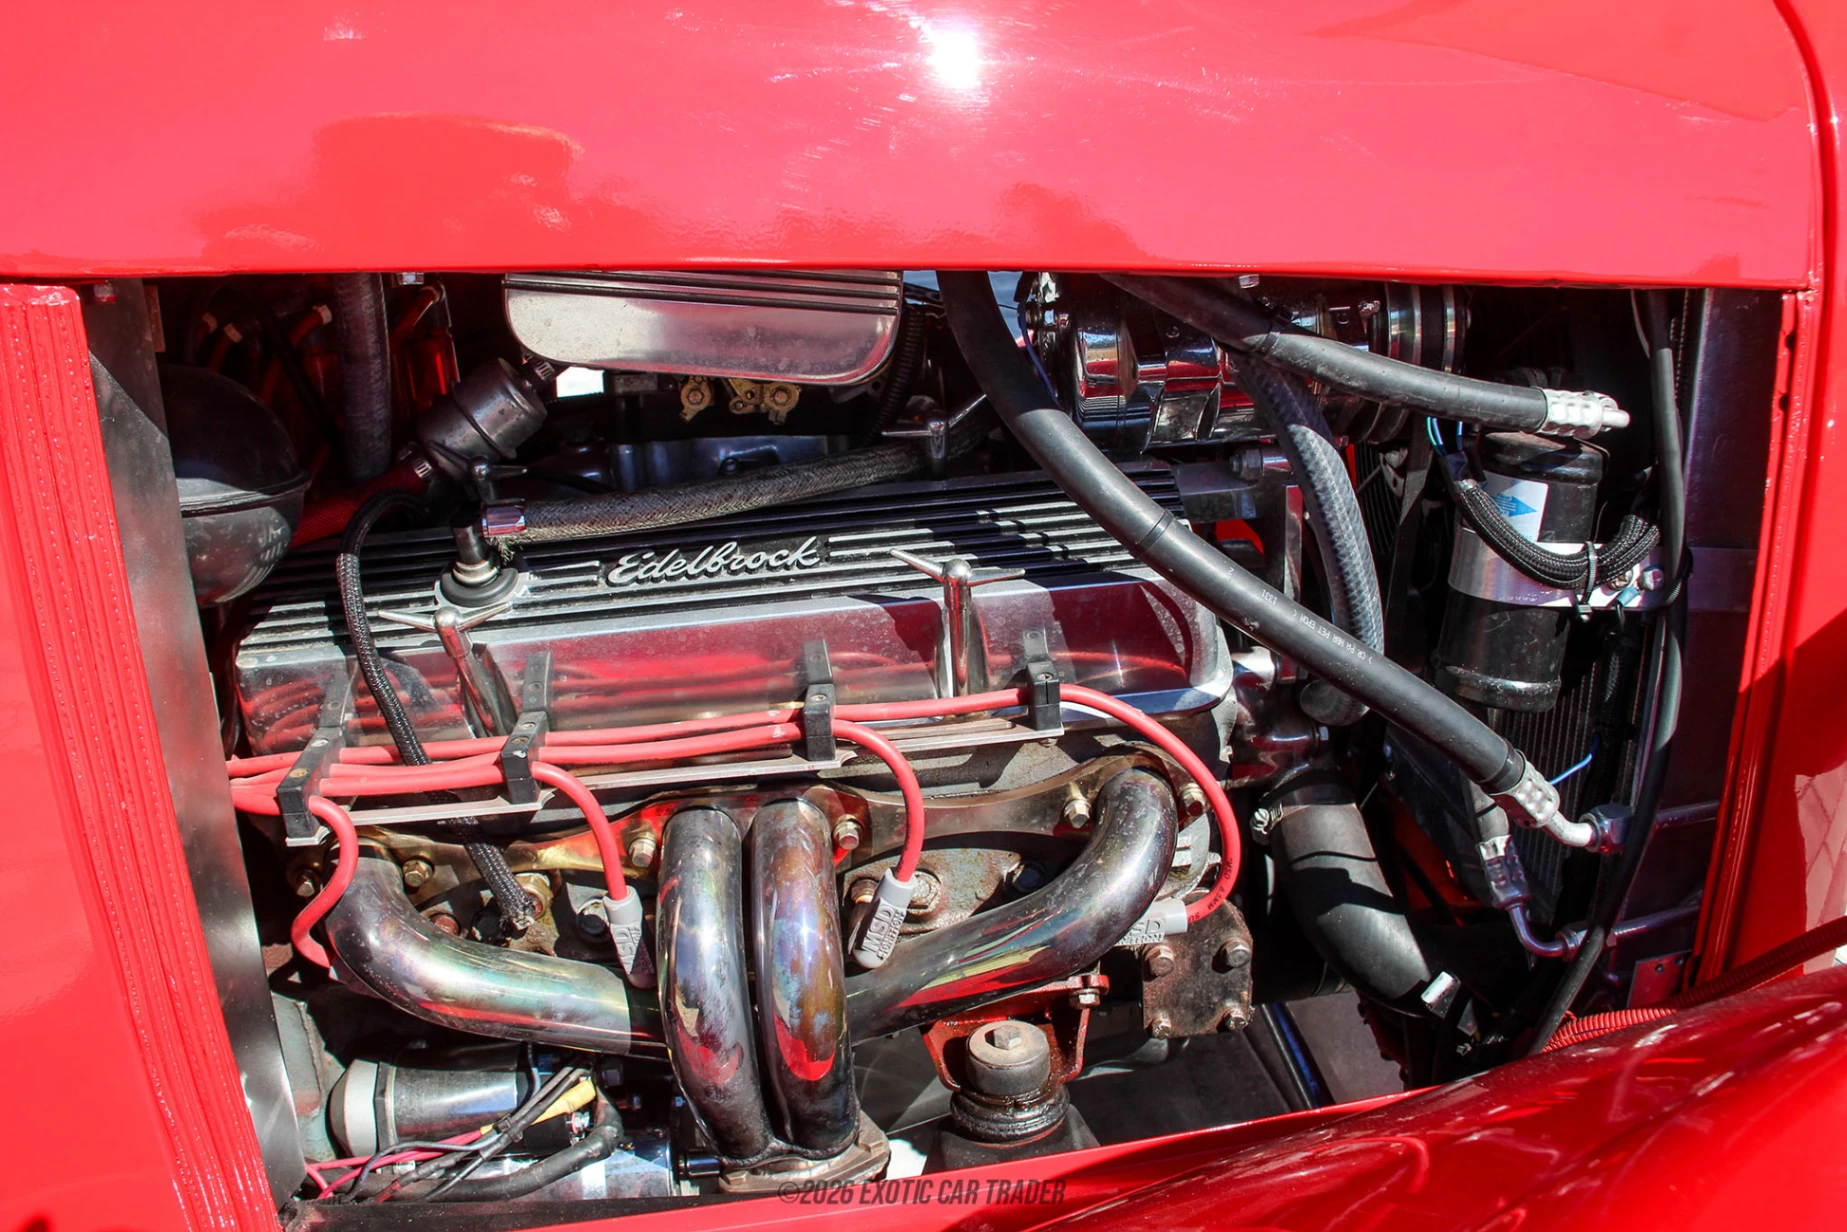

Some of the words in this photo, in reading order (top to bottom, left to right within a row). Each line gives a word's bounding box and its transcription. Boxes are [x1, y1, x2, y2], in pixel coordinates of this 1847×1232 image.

[607, 535, 821, 586] Edelbrock
[1261, 588, 1278, 605] 1331
[1317, 625, 1331, 639] PET
[861, 903, 896, 953] MSD
[1129, 917, 1165, 936] SD
